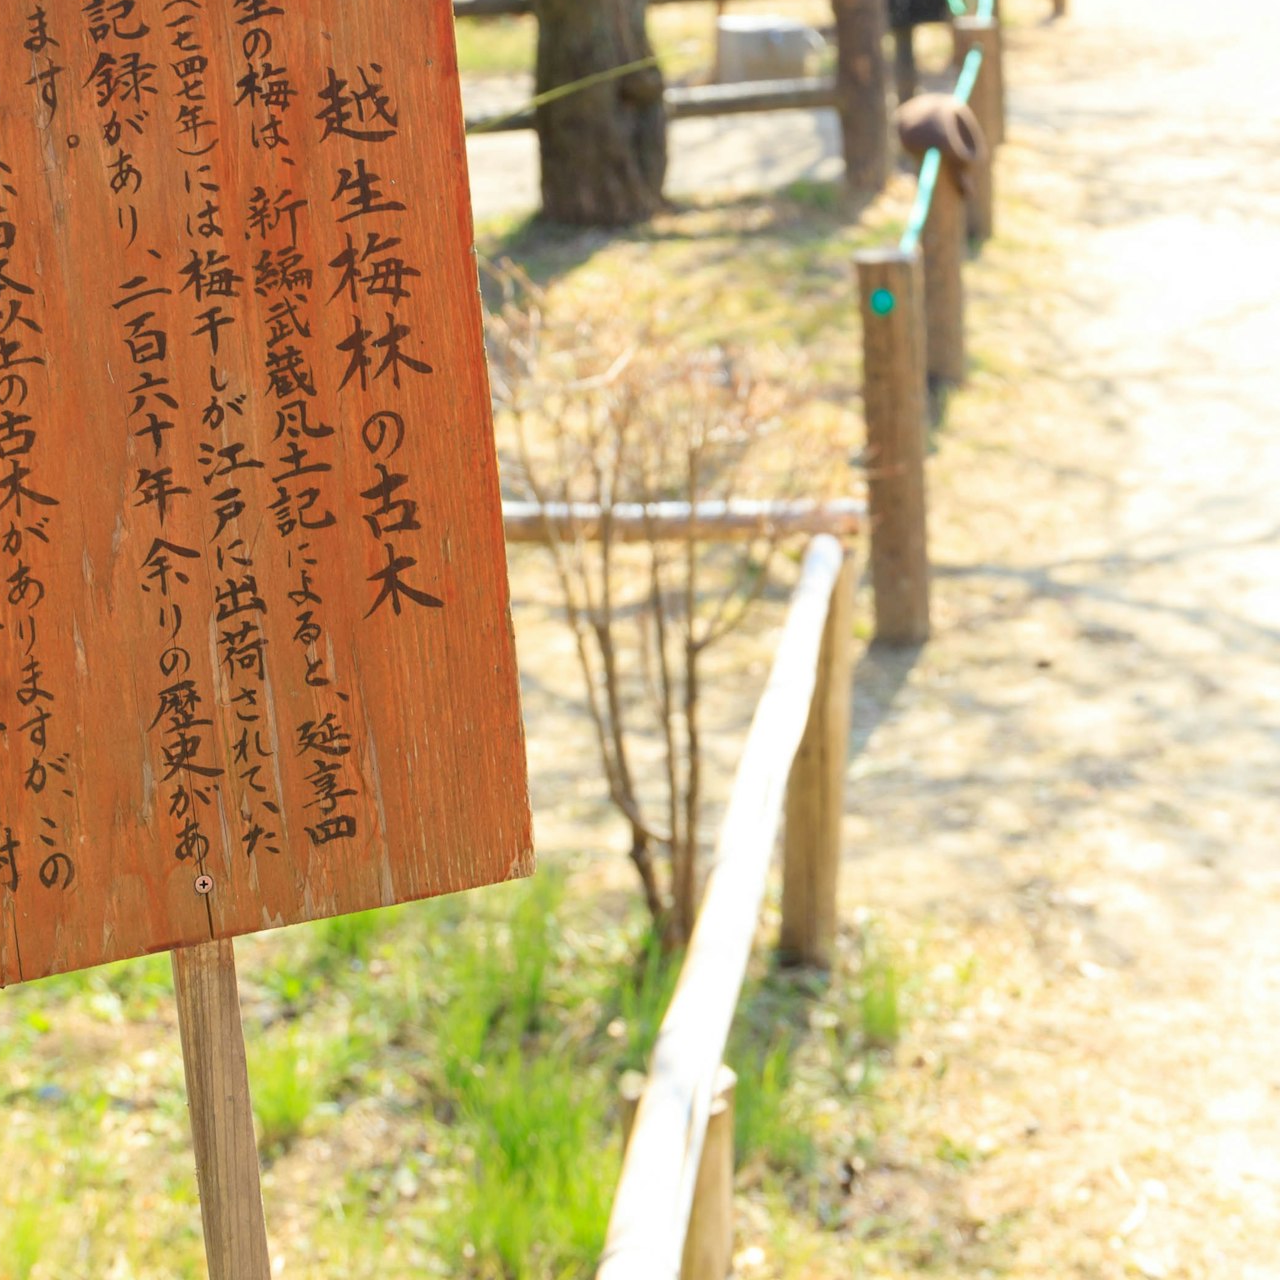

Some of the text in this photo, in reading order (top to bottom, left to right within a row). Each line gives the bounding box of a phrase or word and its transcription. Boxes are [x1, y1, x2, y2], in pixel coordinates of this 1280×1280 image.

[315, 62, 444, 619] 越生梅林の古木
